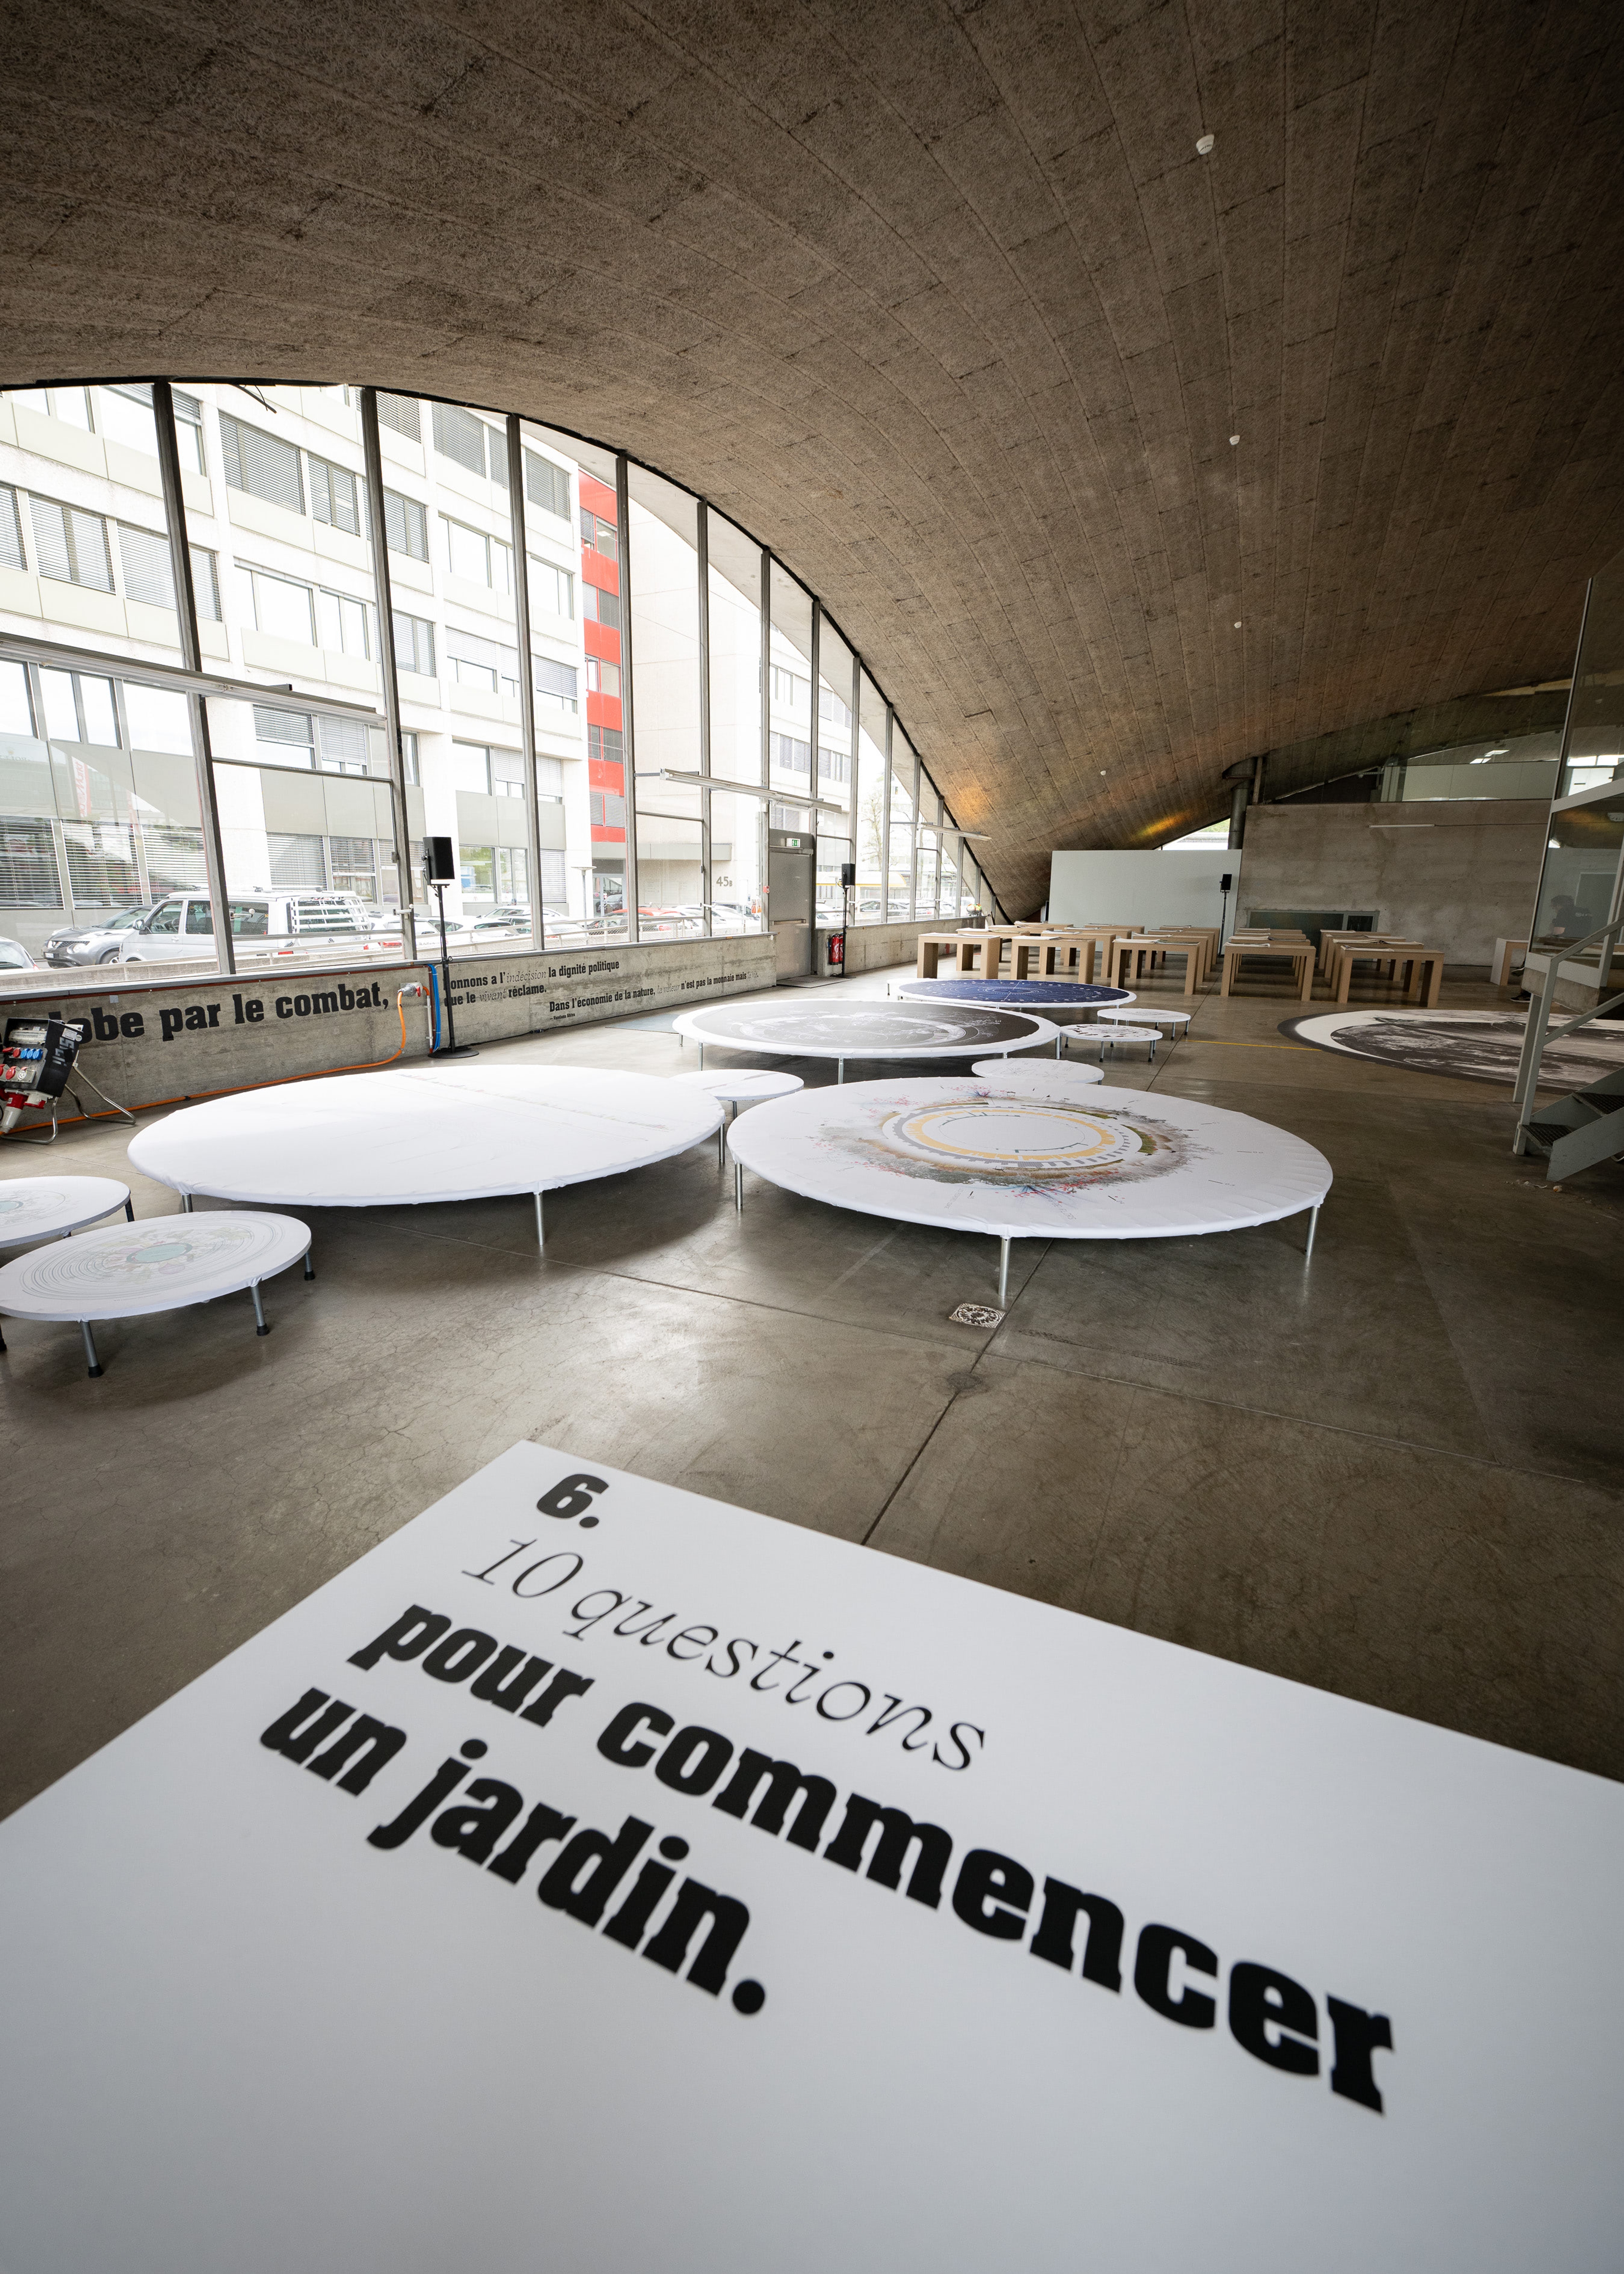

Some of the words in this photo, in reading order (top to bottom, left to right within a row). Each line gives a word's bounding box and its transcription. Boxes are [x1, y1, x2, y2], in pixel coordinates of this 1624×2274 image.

[716, 876, 732, 887] 45B
[443, 976, 488, 990] onnons
[549, 967, 557, 978] la
[559, 963, 586, 978] dignité
[589, 961, 620, 975] politique
[467, 992, 476, 1004] le
[479, 989, 507, 1002] vivant
[508, 985, 547, 997] réclame.
[549, 1001, 570, 1012] Dans
[572, 993, 612, 1008] l'économie
[615, 991, 623, 1001] de
[625, 990, 631, 1000] la
[633, 988, 655, 998] nature,
[657, 985, 662, 994] la
[663, 983, 680, 993] valeur
[681, 980, 695, 990] n'est
[696, 980, 705, 989] pas
[707, 977, 712, 986] la
[713, 974, 734, 984] monnaie
[735, 972, 746, 981] mais
[49, 1007, 145, 1044] obe
[159, 1004, 221, 1042] par
[233, 994, 265, 1024] le
[275, 982, 389, 1019] combat,
[535, 1474, 609, 1529] 6.
[462, 1538, 583, 1599] 10
[562, 1588, 986, 1771] questions
[259, 1687, 406, 1796] un
[367, 1738, 765, 2016] jardin.
[346, 1604, 595, 1727] pour
[596, 1701, 1393, 2115] commencer
